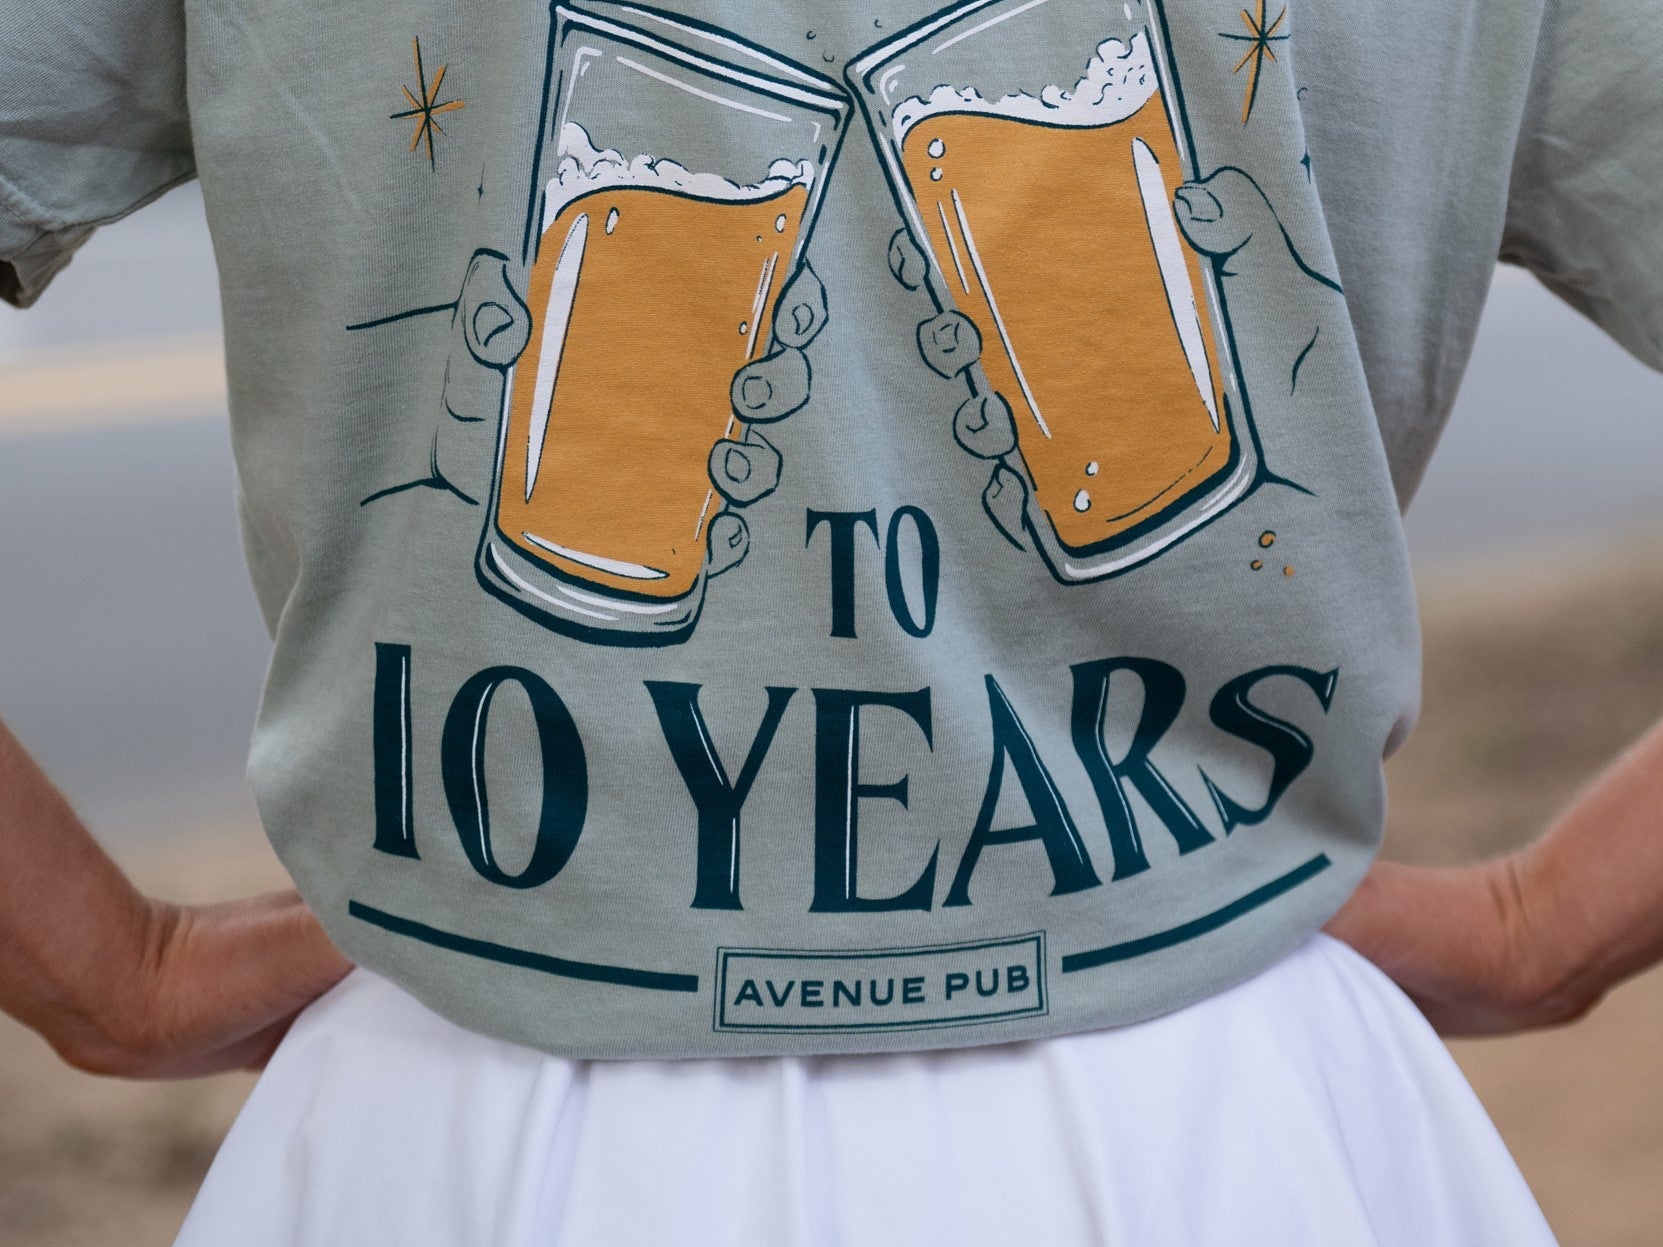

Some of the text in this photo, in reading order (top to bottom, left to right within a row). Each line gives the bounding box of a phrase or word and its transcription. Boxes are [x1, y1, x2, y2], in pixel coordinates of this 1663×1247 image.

[805, 505, 941, 640] TO
[372, 641, 1341, 914] 10 YEARS
[734, 965, 1030, 1008] AVENUE PUB
